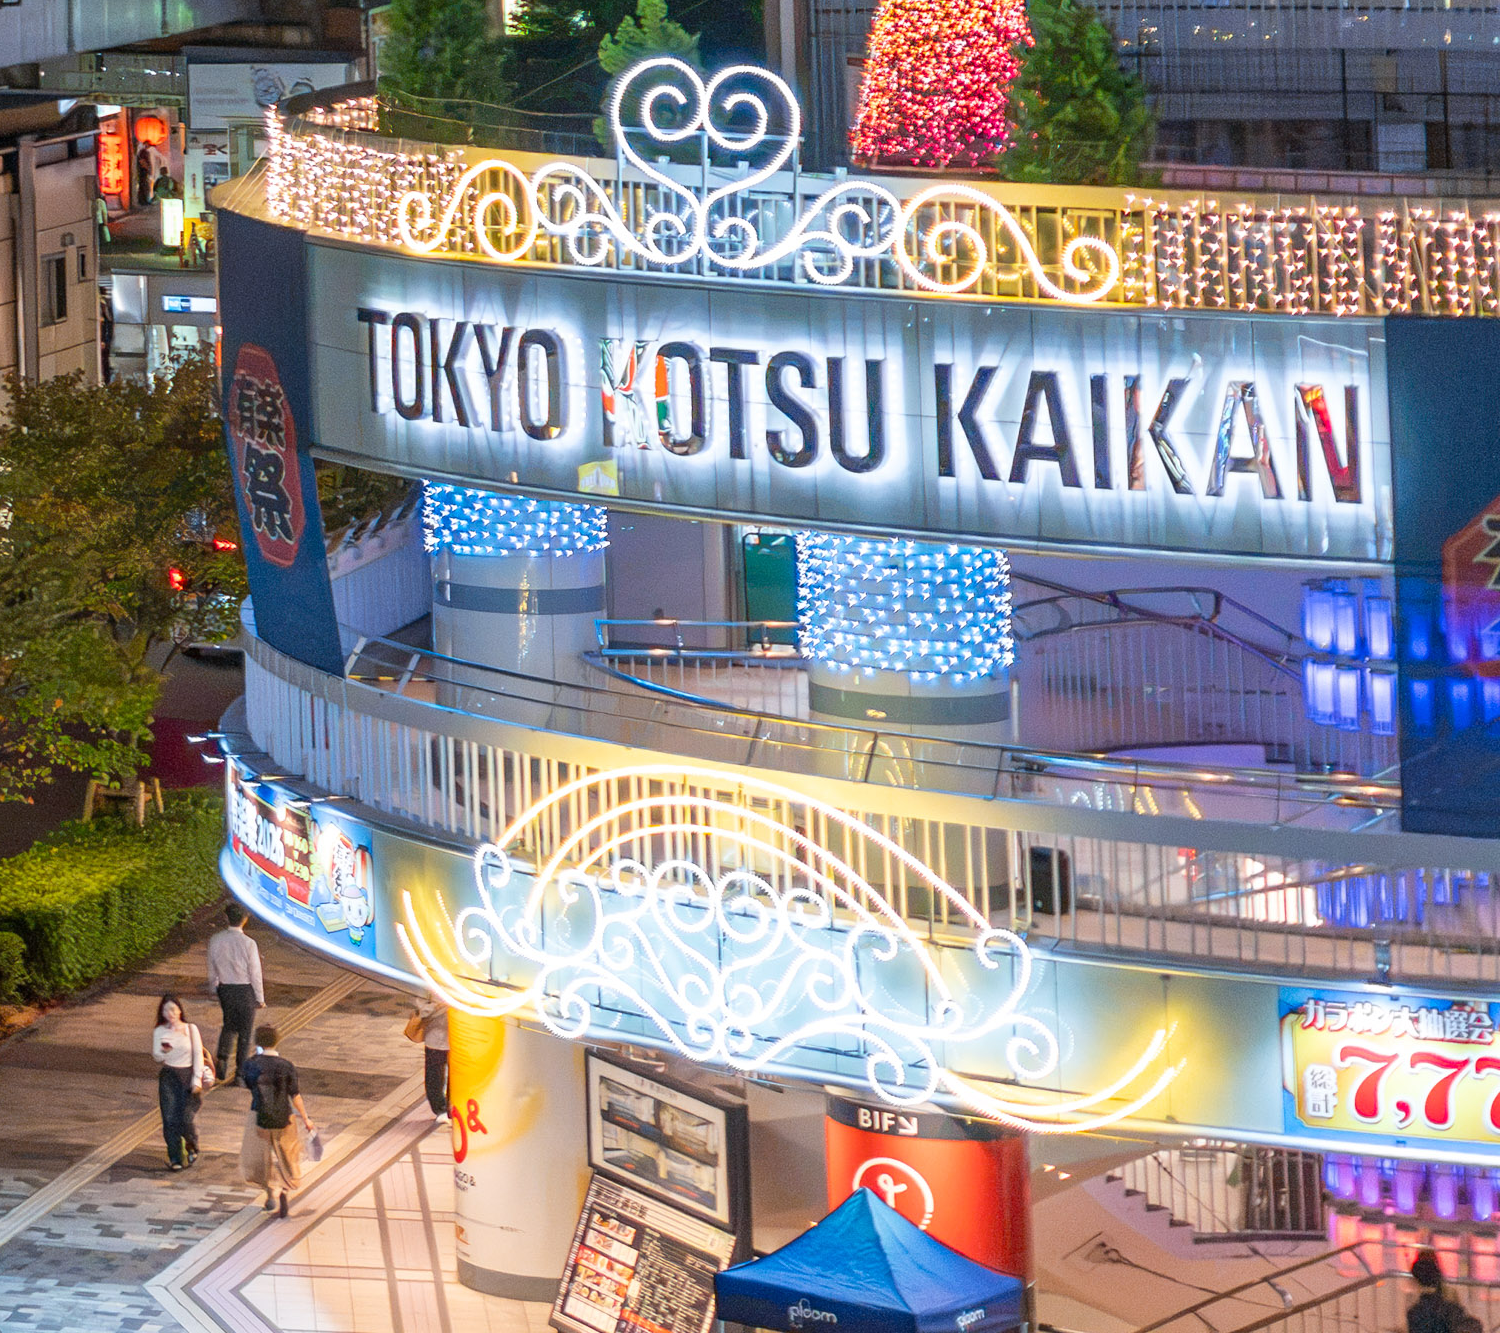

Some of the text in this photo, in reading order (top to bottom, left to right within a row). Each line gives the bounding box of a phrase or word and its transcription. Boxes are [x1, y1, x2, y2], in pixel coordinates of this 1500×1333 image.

[357, 305, 1364, 507] TOKYO KOTSU KAIKAN
[1302, 997, 1496, 1044] ガラポン大抽選会
